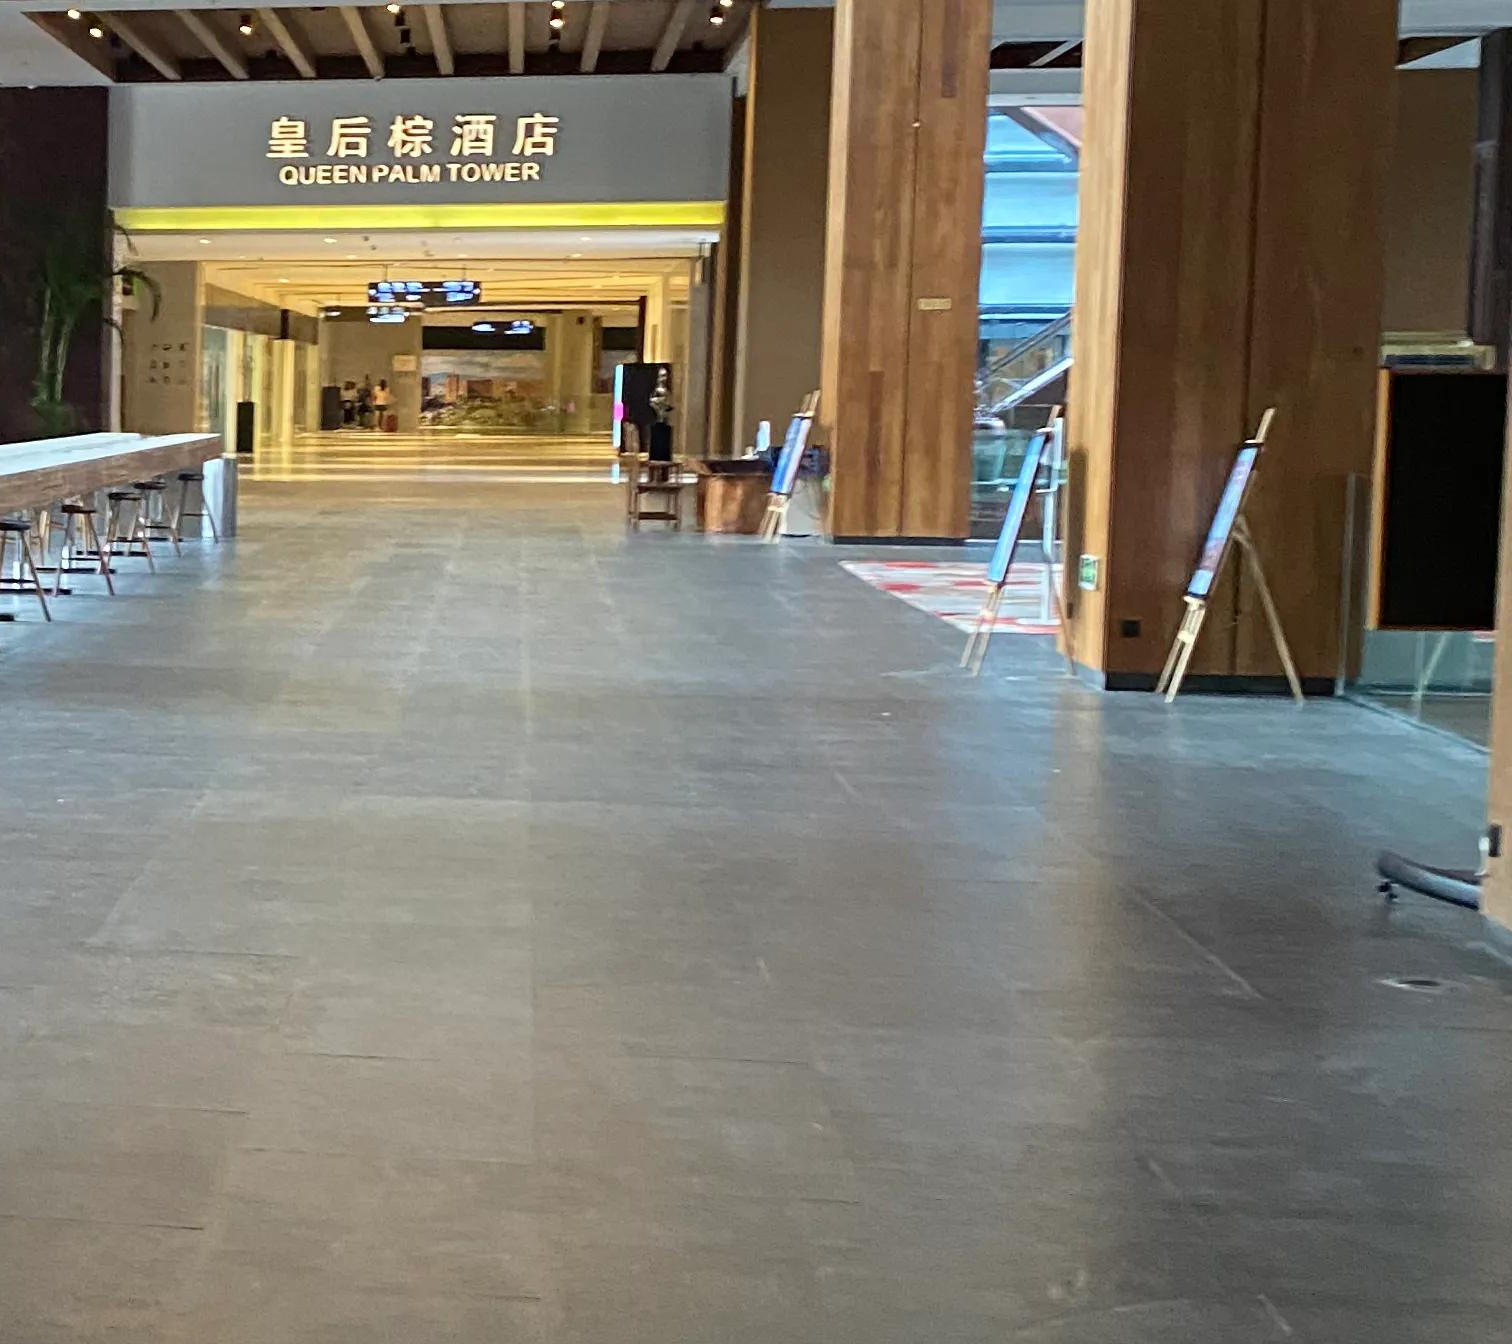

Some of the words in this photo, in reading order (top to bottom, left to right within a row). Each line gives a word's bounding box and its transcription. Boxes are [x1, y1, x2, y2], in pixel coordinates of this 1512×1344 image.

[266, 112, 559, 158] 皇后棕酒店
[279, 164, 367, 185] QUEEN
[372, 163, 440, 184] PALM
[445, 162, 541, 182] TOWER
